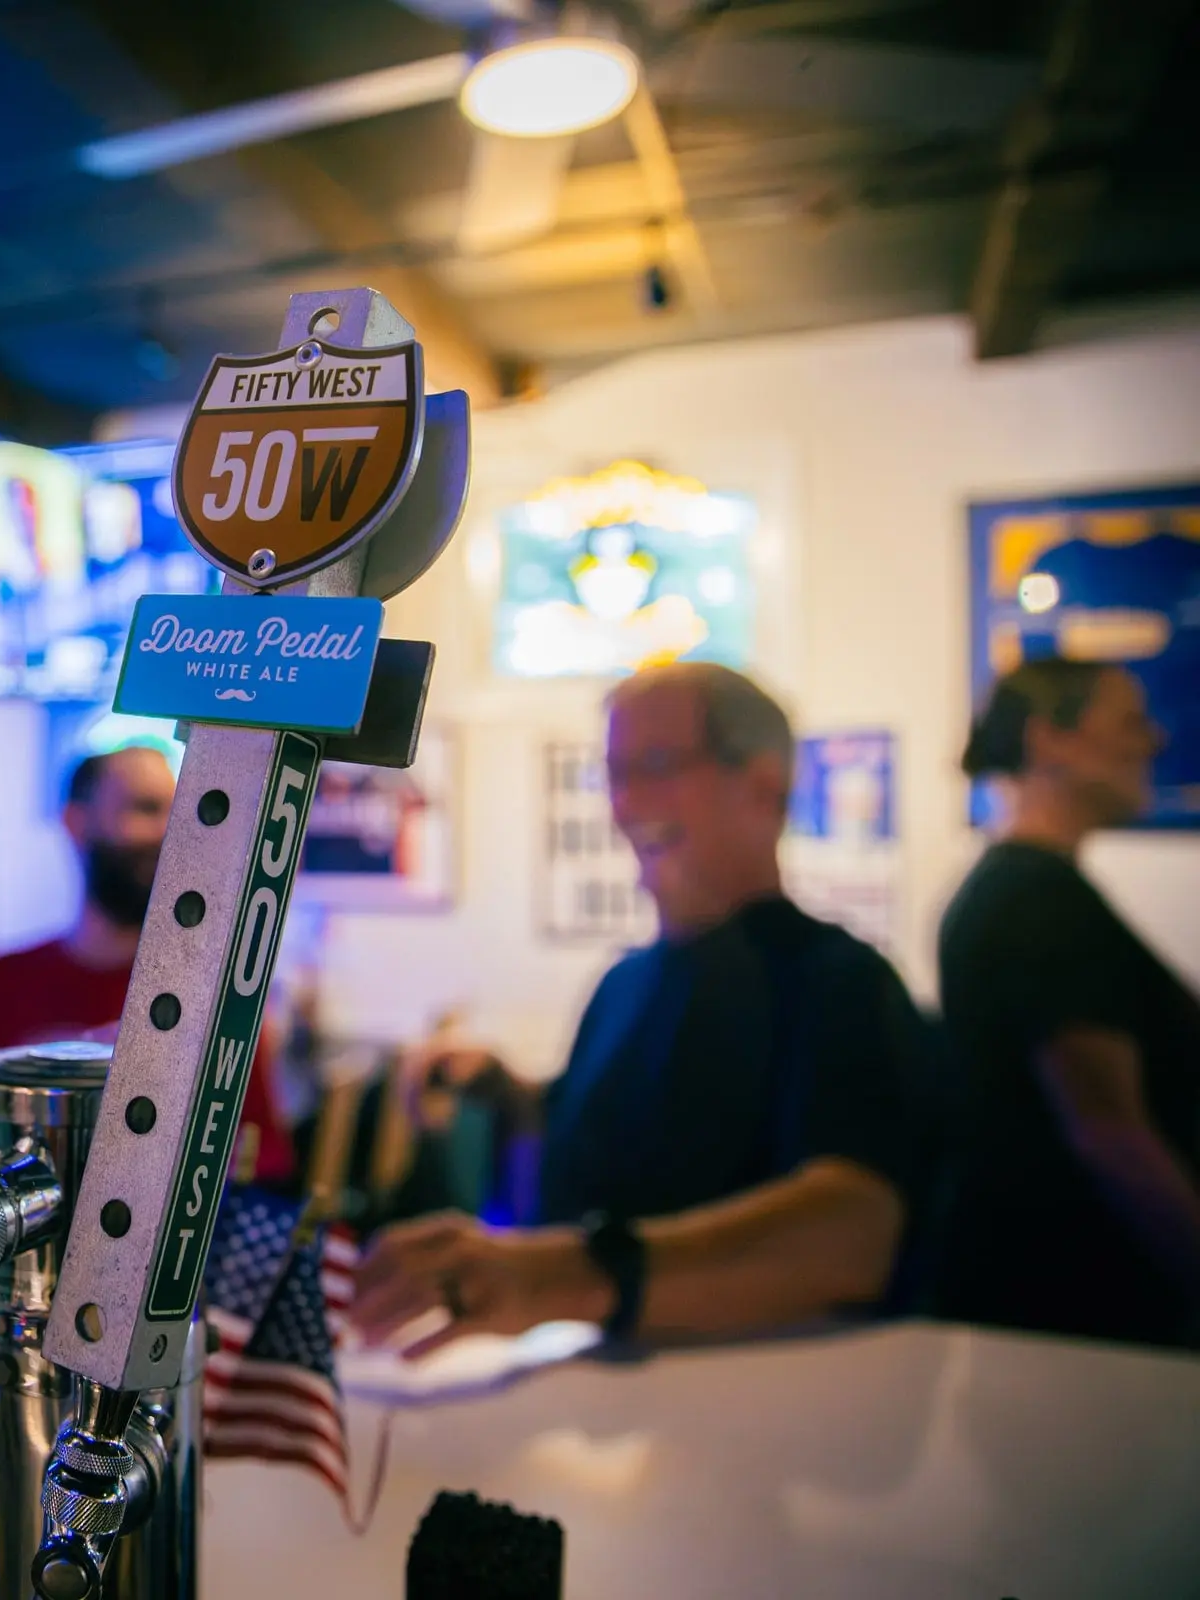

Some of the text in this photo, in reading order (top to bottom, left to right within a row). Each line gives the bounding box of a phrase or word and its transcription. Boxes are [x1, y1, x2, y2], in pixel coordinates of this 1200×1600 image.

[230, 366, 382, 403] FIFTY WEST
[202, 427, 376, 522] 50W
[139, 614, 364, 661] Doom Pedal
[186, 661, 299, 683] WHITE ALE
[173, 765, 306, 1281] 50 WEST
